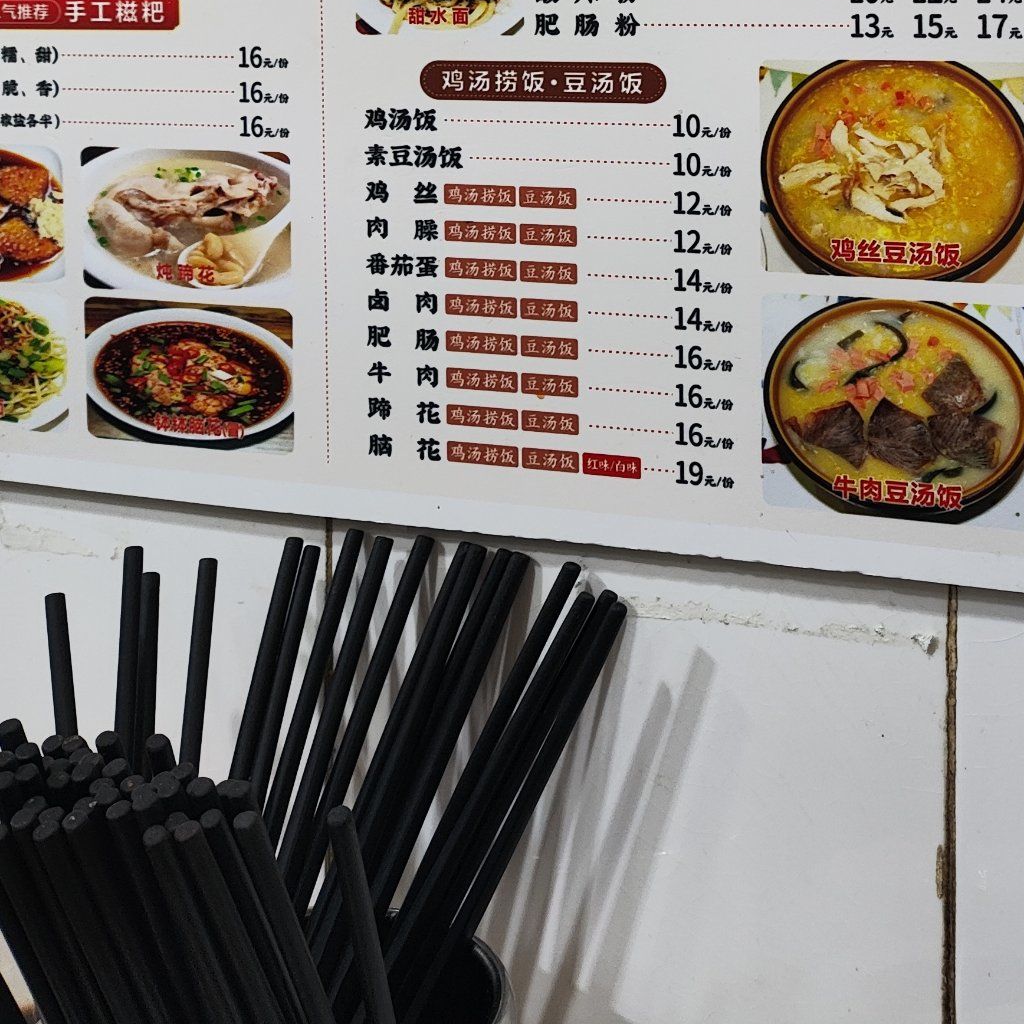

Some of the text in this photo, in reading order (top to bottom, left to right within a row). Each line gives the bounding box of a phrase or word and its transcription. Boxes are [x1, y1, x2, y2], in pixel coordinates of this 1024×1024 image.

[0, 0, 165, 24] 气推荐 手工糍粑
[238, 46, 289, 69] 16元/份
[364, 107, 732, 139] 鸡汤饭 10元/份
[364, 144, 464, 170] 素豆汤饭
[447, 186, 574, 208] 鸡汤捞饭 豆汤饭
[365, 253, 439, 277] 番茄蛋
[830, 237, 963, 268] 鸡丝豆汤饭
[833, 475, 963, 511] 牛肉豆汤饭
